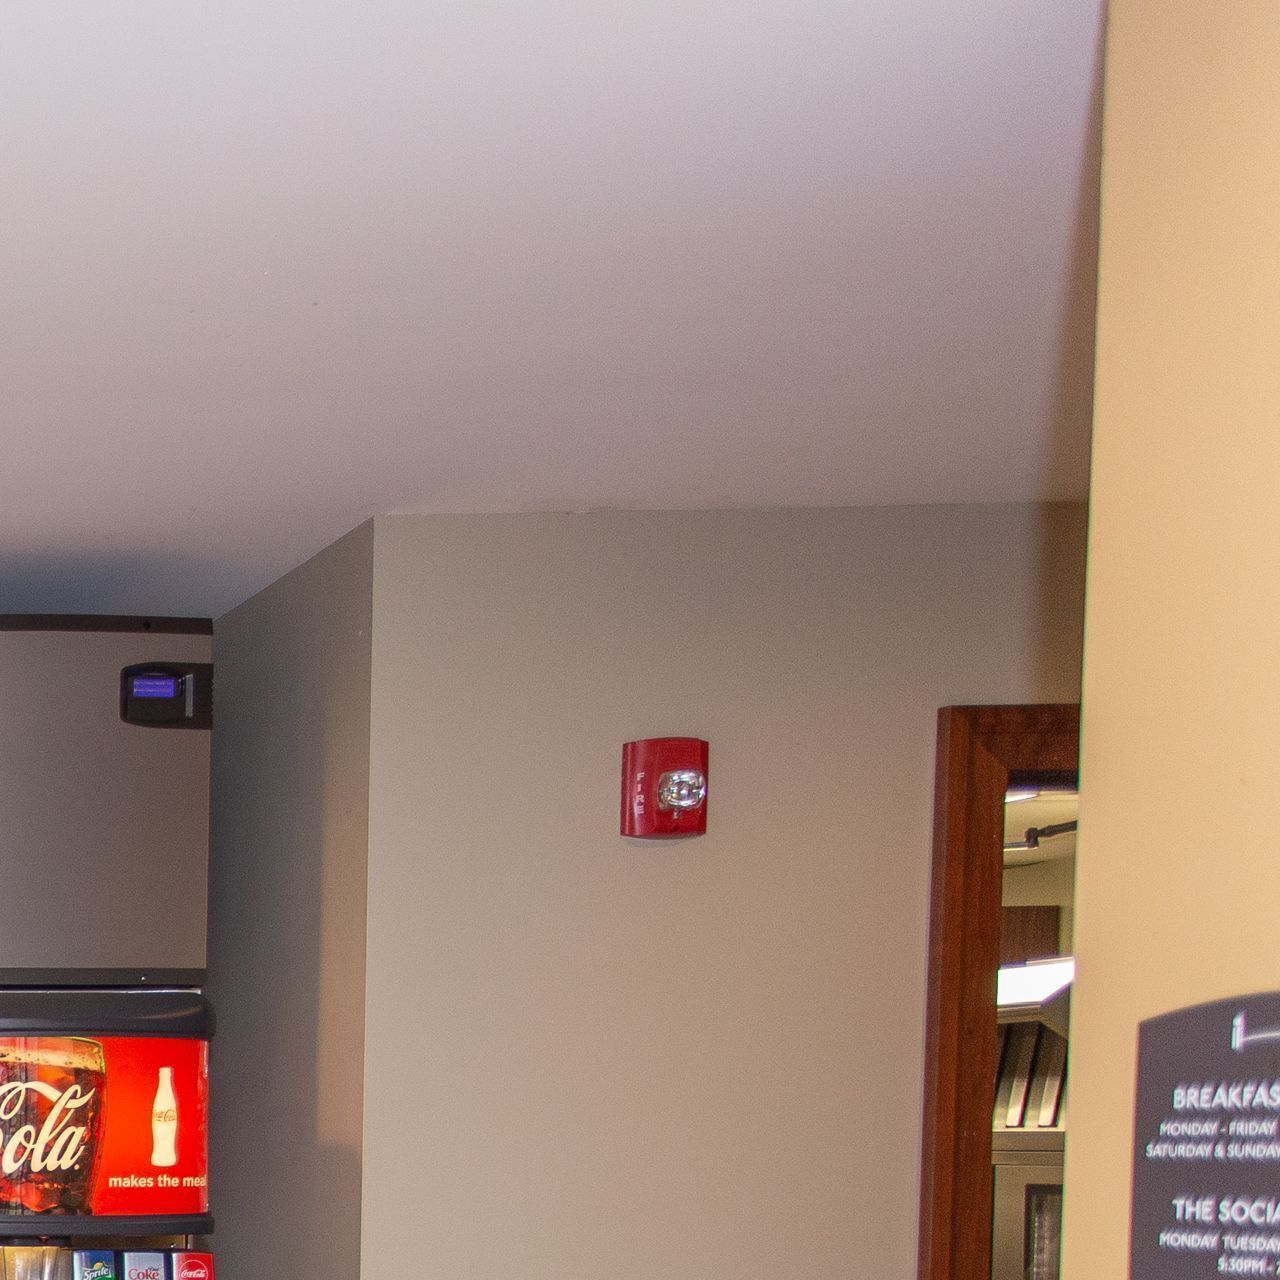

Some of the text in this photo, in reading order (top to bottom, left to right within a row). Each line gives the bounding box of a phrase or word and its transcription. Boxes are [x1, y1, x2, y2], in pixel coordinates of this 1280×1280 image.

[636, 772, 644, 814] FIRE
[1160, 1121, 1219, 1136] MONDAY
[1228, 1121, 1277, 1136] FRIDAY
[1146, 1143, 1213, 1158] SATURDAY
[1214, 1144, 1225, 1158] &
[108, 1174, 154, 1188] makes
[157, 1174, 180, 1188] the
[1172, 1197, 1215, 1221] THE
[1159, 1231, 1219, 1248] MONDAY
[128, 1267, 160, 1280] Coke
[180, 1269, 206, 1278] Coca-Cola
